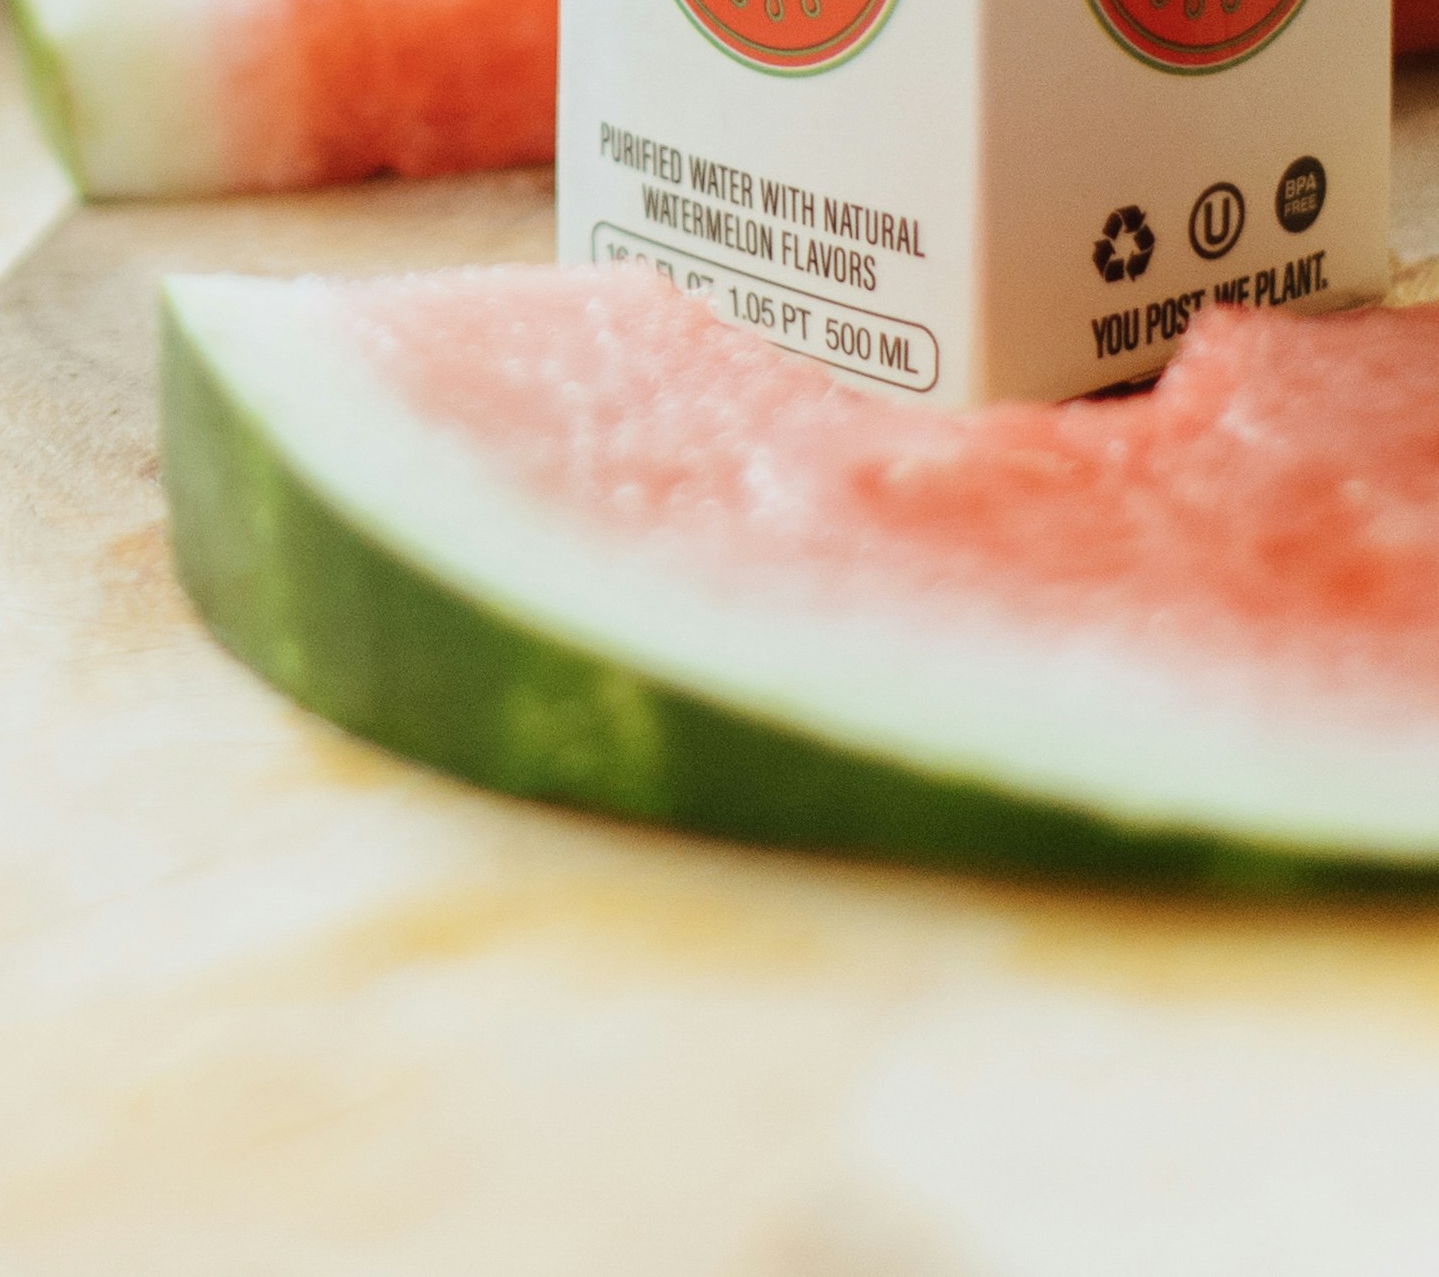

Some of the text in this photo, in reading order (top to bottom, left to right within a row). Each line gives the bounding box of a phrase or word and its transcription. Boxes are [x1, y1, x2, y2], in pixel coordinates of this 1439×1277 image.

[599, 120, 926, 259] PURIFIED WATER WITH NATURAL
[1284, 195, 1317, 218] FREE
[1285, 171, 1317, 199] BPA
[641, 182, 878, 292] WATERMELON FLAVORS
[728, 285, 776, 329] 1.05
[781, 301, 813, 341] PT
[825, 316, 872, 361] 500
[879, 331, 920, 376] ML
[1091, 307, 1140, 360] YOU
[1146, 288, 1206, 345] POST
[1255, 249, 1329, 308] PLANT.
